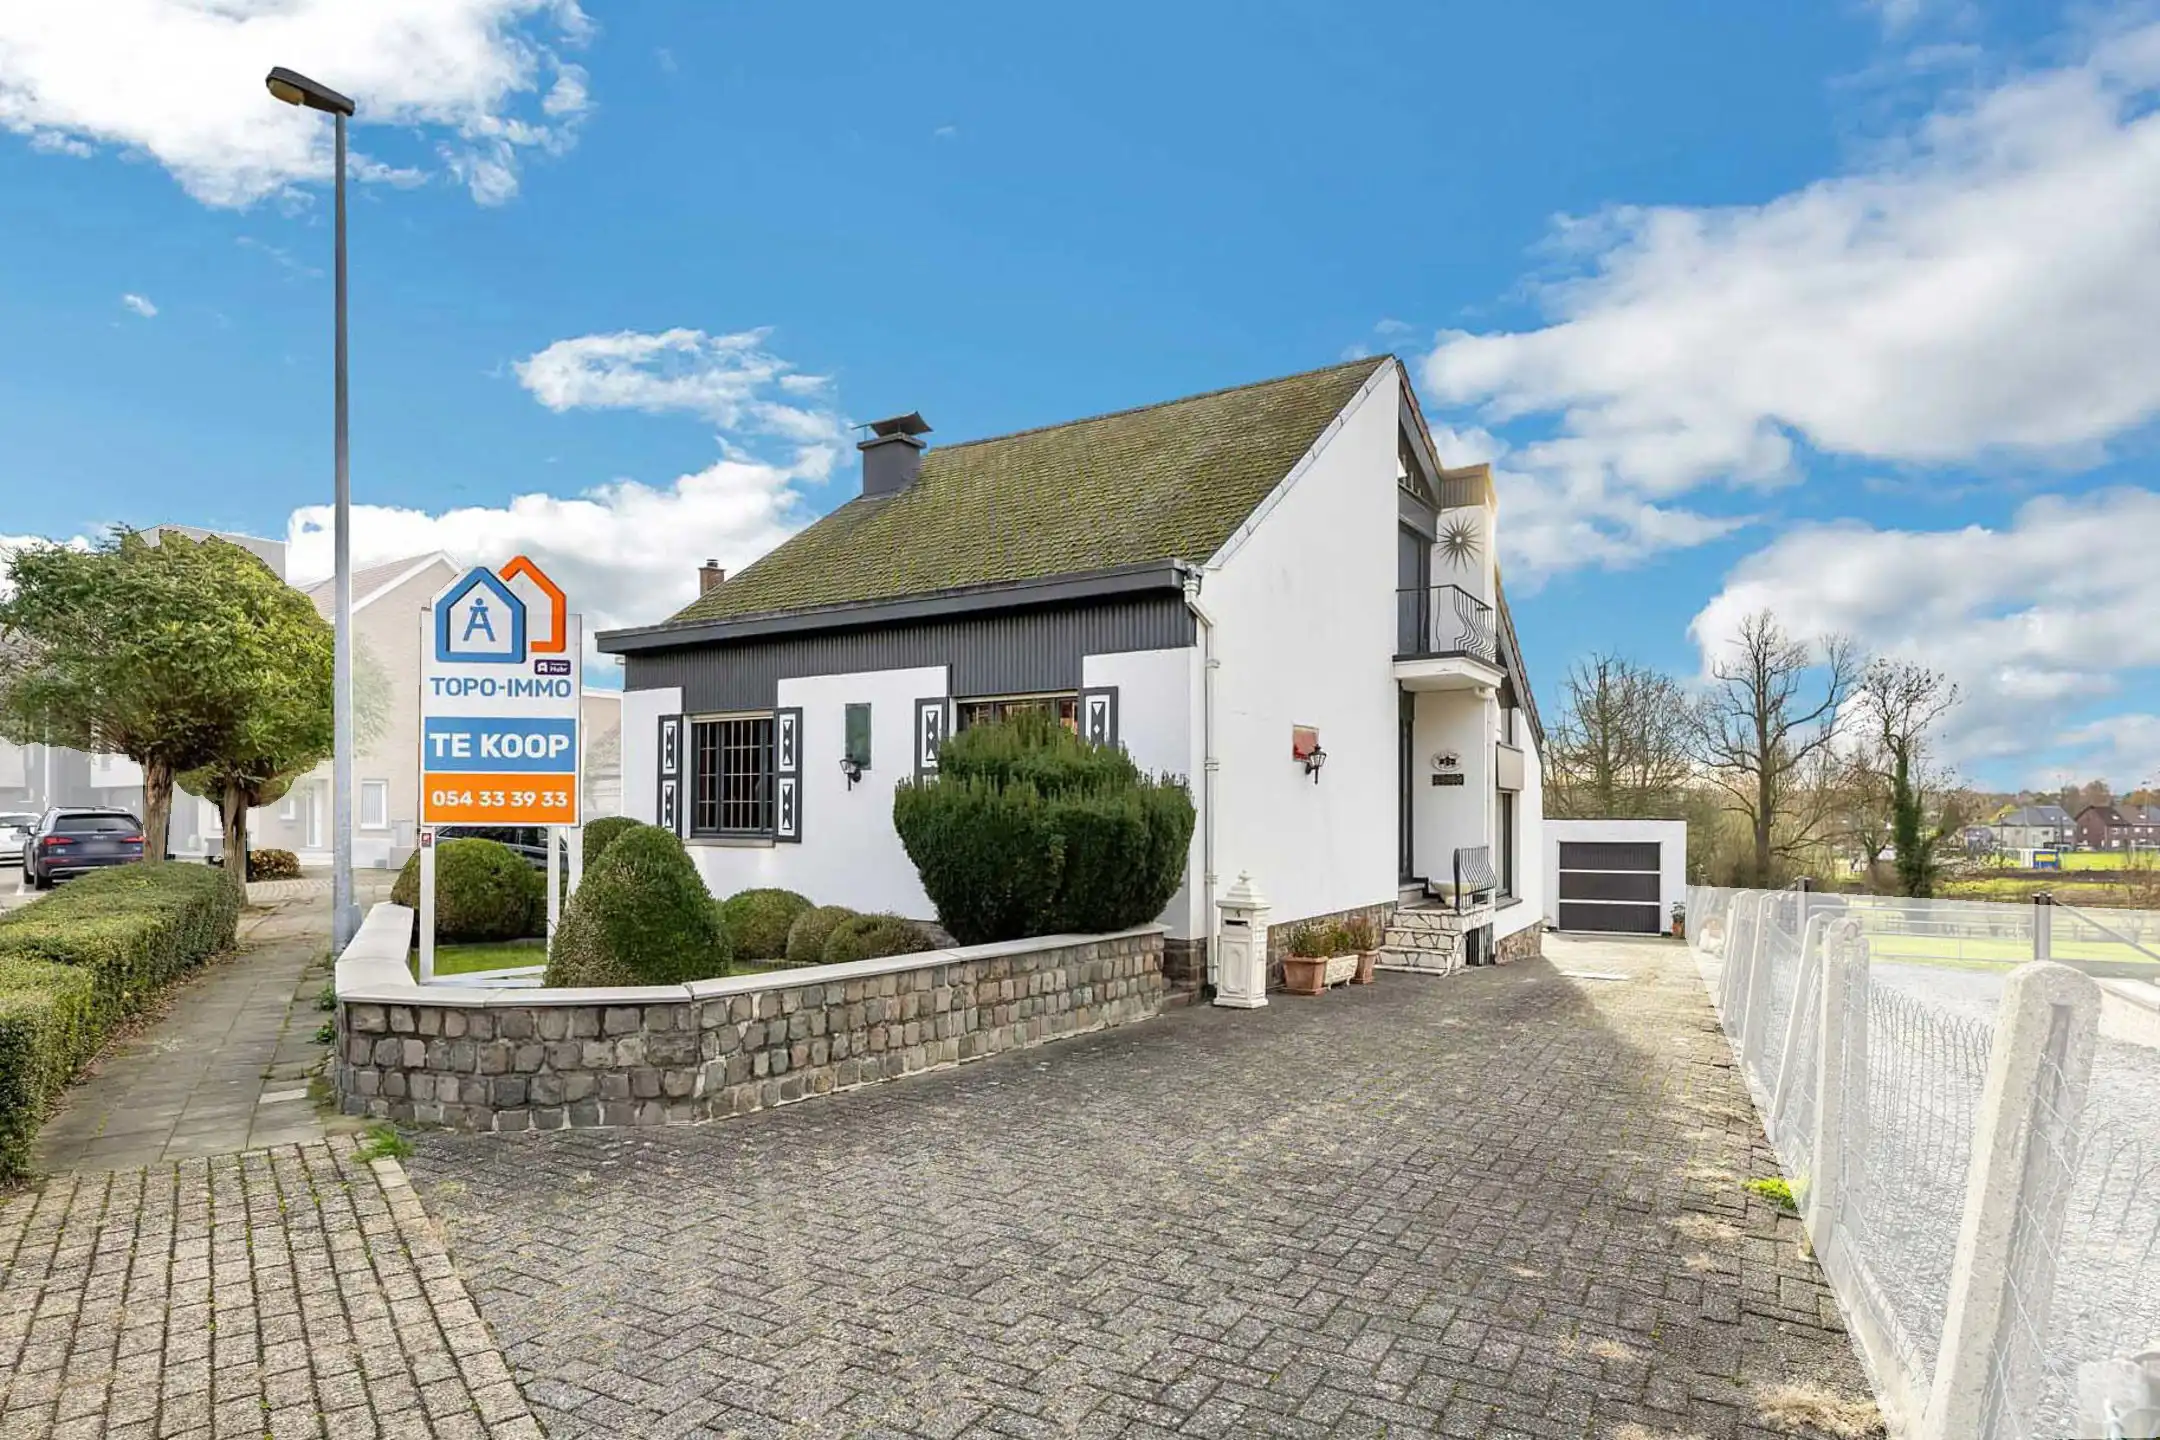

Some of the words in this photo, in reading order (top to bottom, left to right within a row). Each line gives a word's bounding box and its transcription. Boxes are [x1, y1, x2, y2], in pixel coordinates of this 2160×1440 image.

[430, 677, 571, 698] TOPO-IMMO
[429, 733, 472, 758] TE
[480, 733, 570, 759] KOOP
[432, 790, 473, 807] 054
[479, 791, 505, 807] 33
[511, 791, 537, 807] 39
[541, 791, 568, 808] 33
